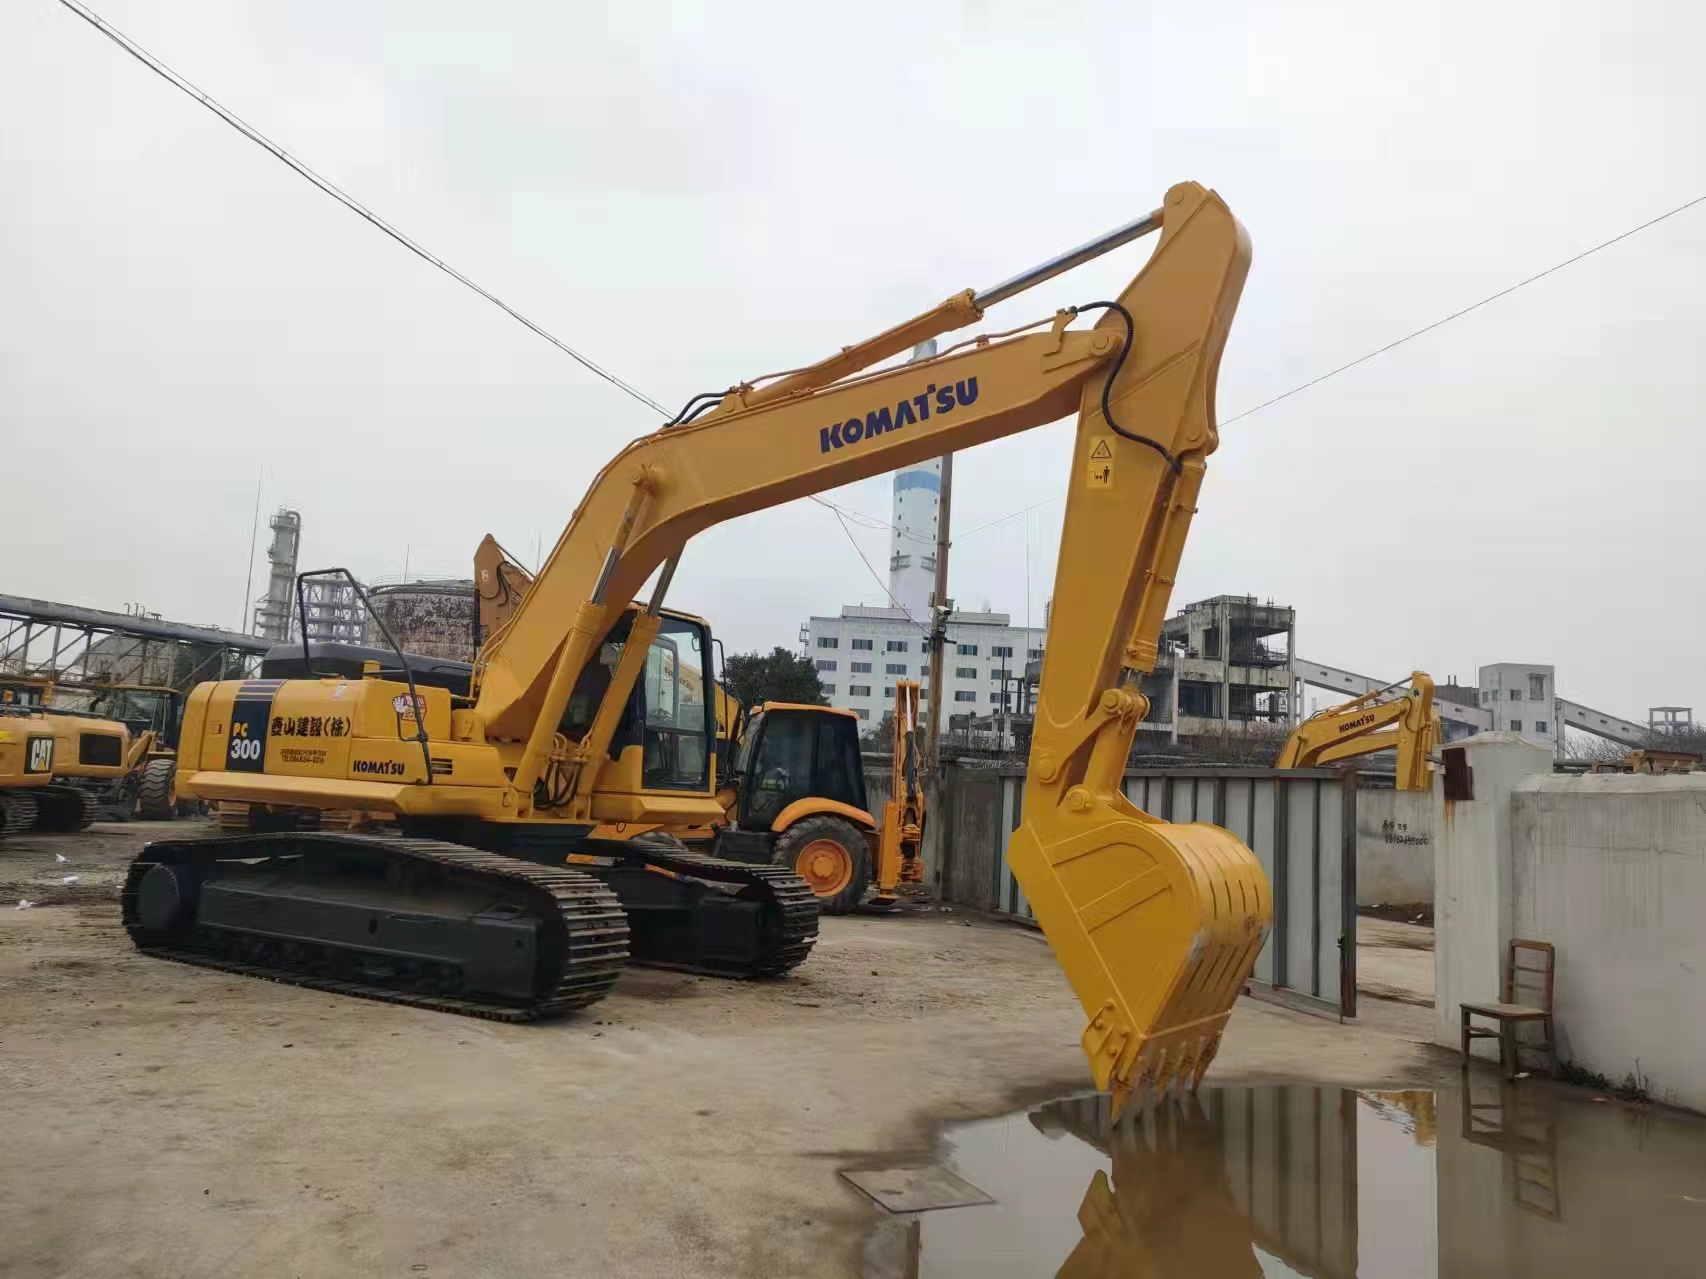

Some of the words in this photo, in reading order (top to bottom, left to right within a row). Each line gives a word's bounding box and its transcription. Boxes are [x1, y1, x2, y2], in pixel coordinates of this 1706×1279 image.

[820, 376, 979, 454] KOMATSU
[233, 722, 249, 738] PC
[1339, 713, 1375, 733] KOMATSU
[31, 739, 53, 771] CAT
[231, 738, 261, 760] 300
[353, 760, 405, 775] KOMATSU
